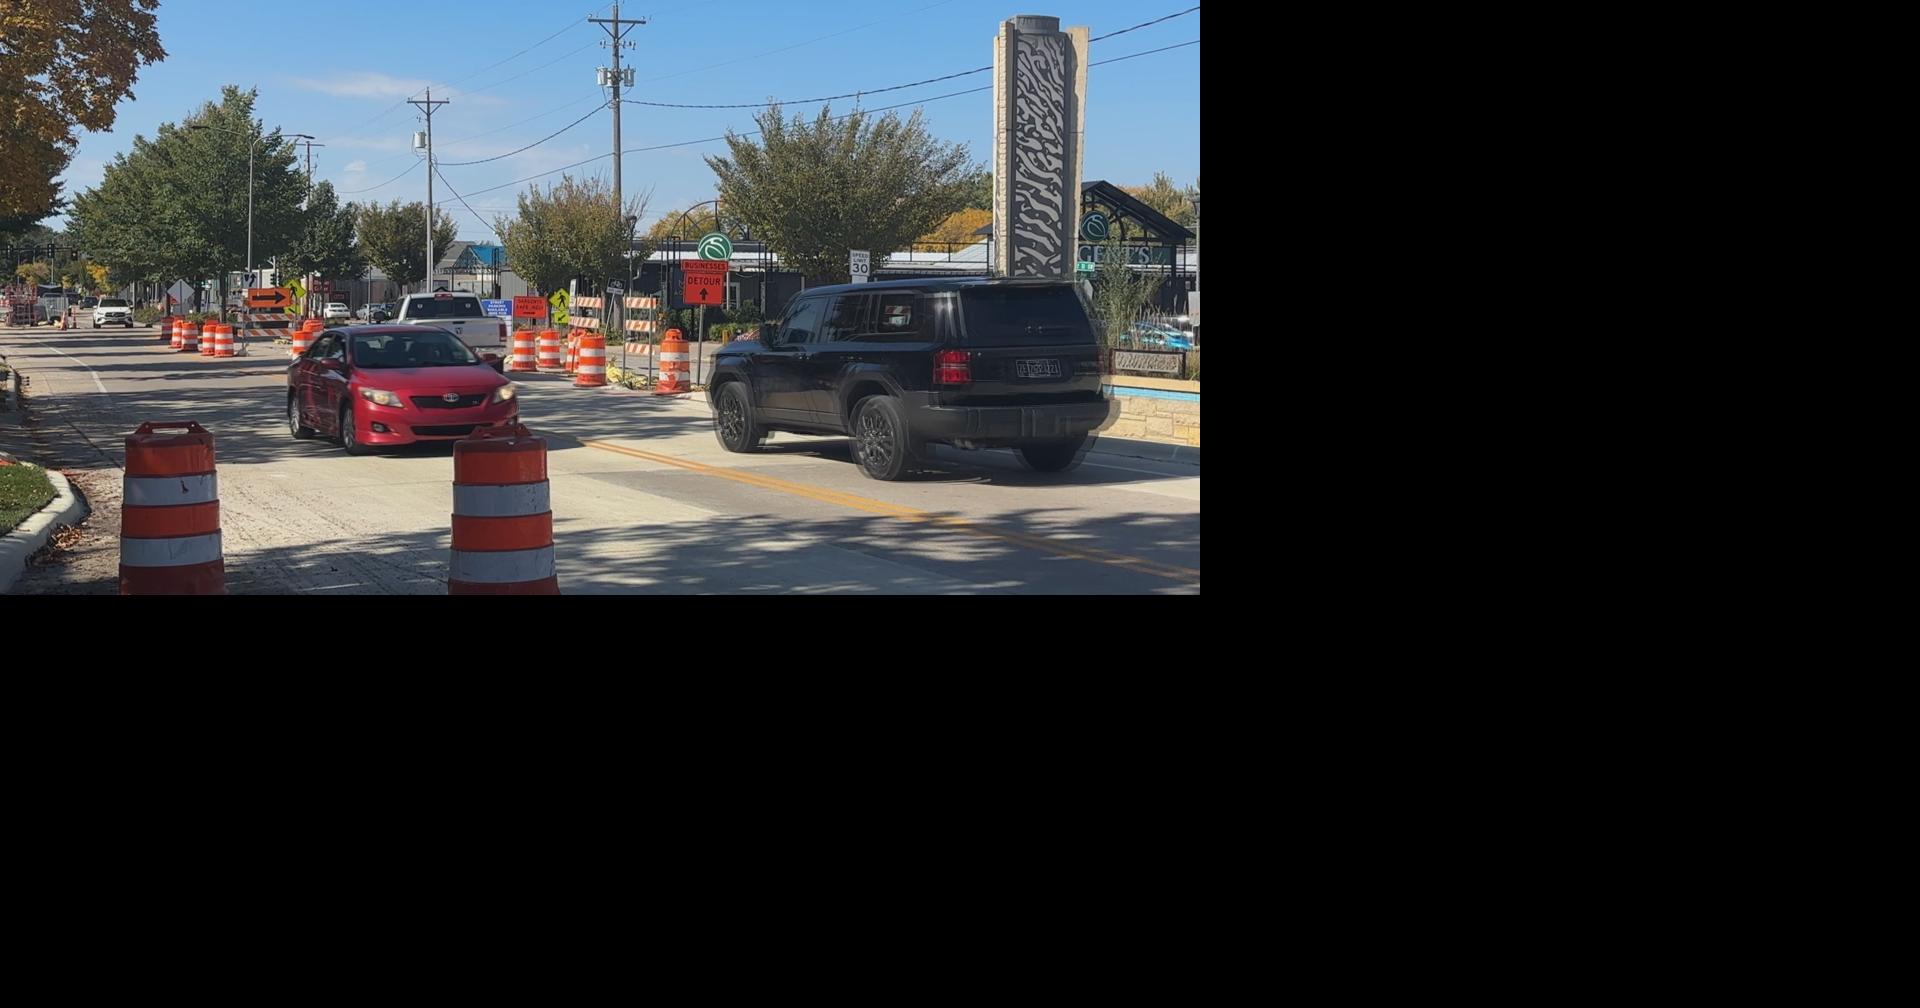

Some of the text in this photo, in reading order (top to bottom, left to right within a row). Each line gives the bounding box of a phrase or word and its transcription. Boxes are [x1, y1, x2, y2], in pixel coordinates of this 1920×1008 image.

[685, 262, 725, 270] BUSINESSES
[852, 263, 868, 274] 30
[688, 277, 720, 285] DETOUR
